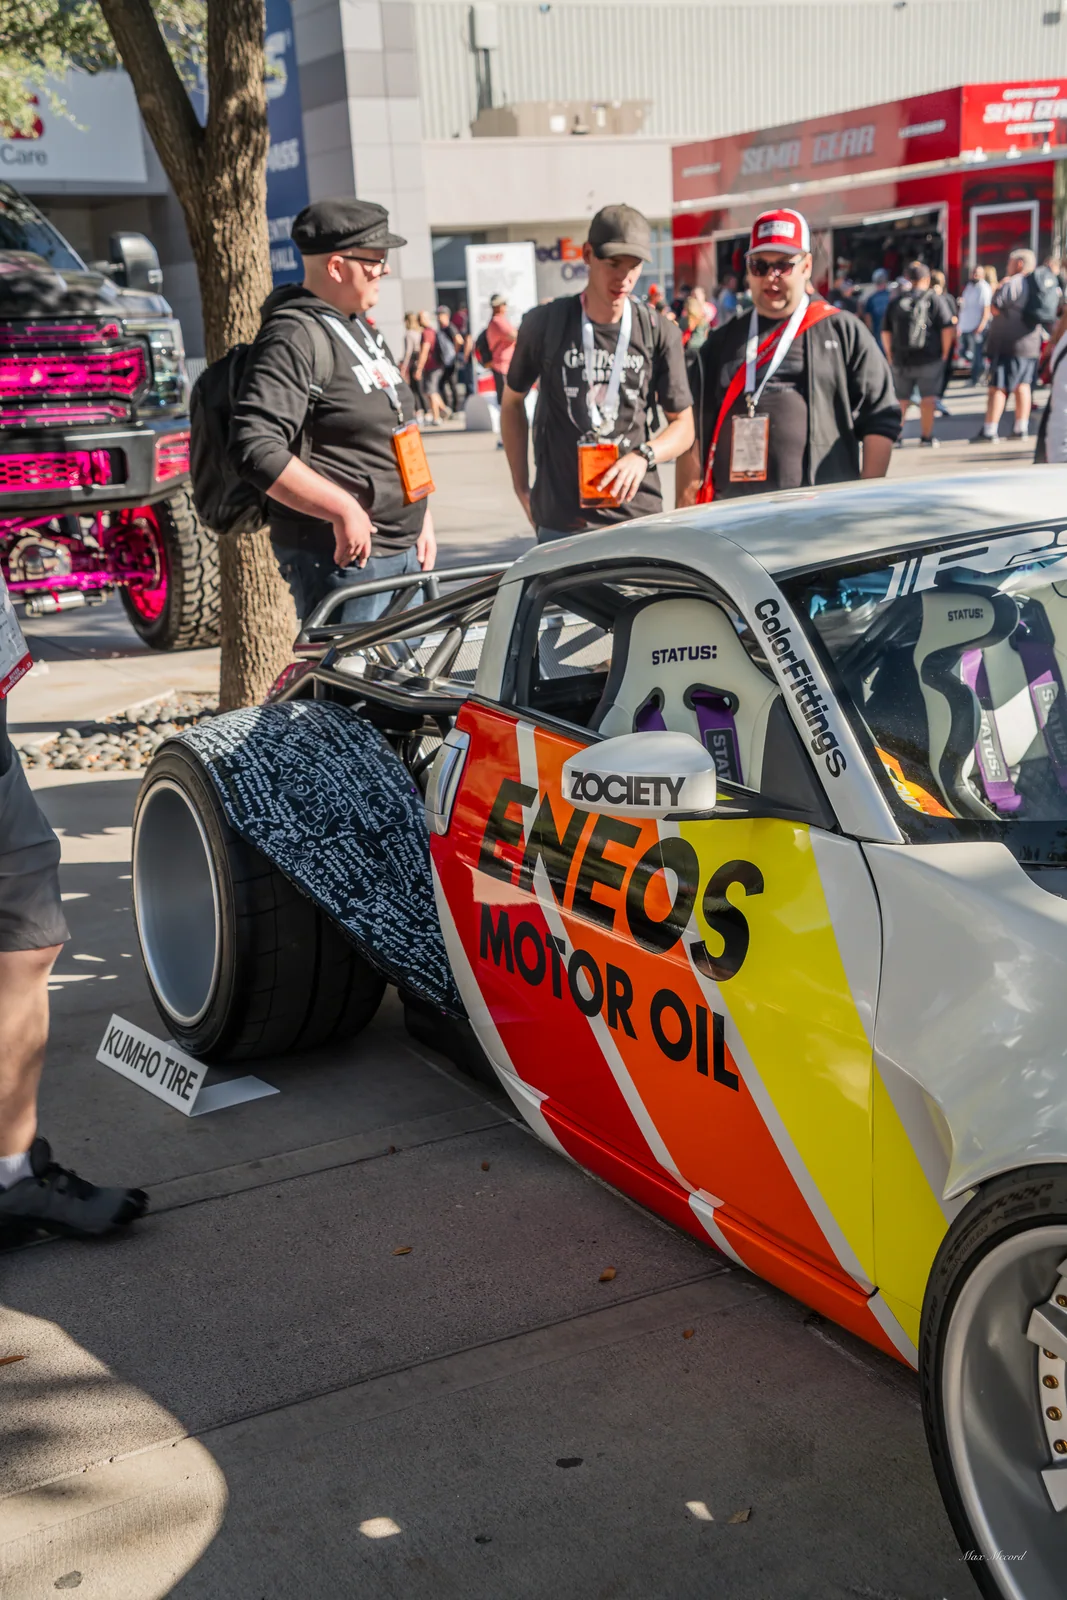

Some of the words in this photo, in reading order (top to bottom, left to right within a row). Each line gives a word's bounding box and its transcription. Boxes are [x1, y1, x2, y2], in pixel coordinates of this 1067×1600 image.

[739, 140, 802, 176] SEMA
[811, 124, 876, 164] GEAR
[652, 645, 718, 665] STATUS:
[570, 770, 687, 808] ZOCIETY
[477, 777, 765, 982] ENEOS
[479, 901, 638, 1041] MOTOR
[649, 988, 740, 1093] OIL
[103, 1025, 162, 1079] KUMHO
[159, 1056, 199, 1102] TIRE
